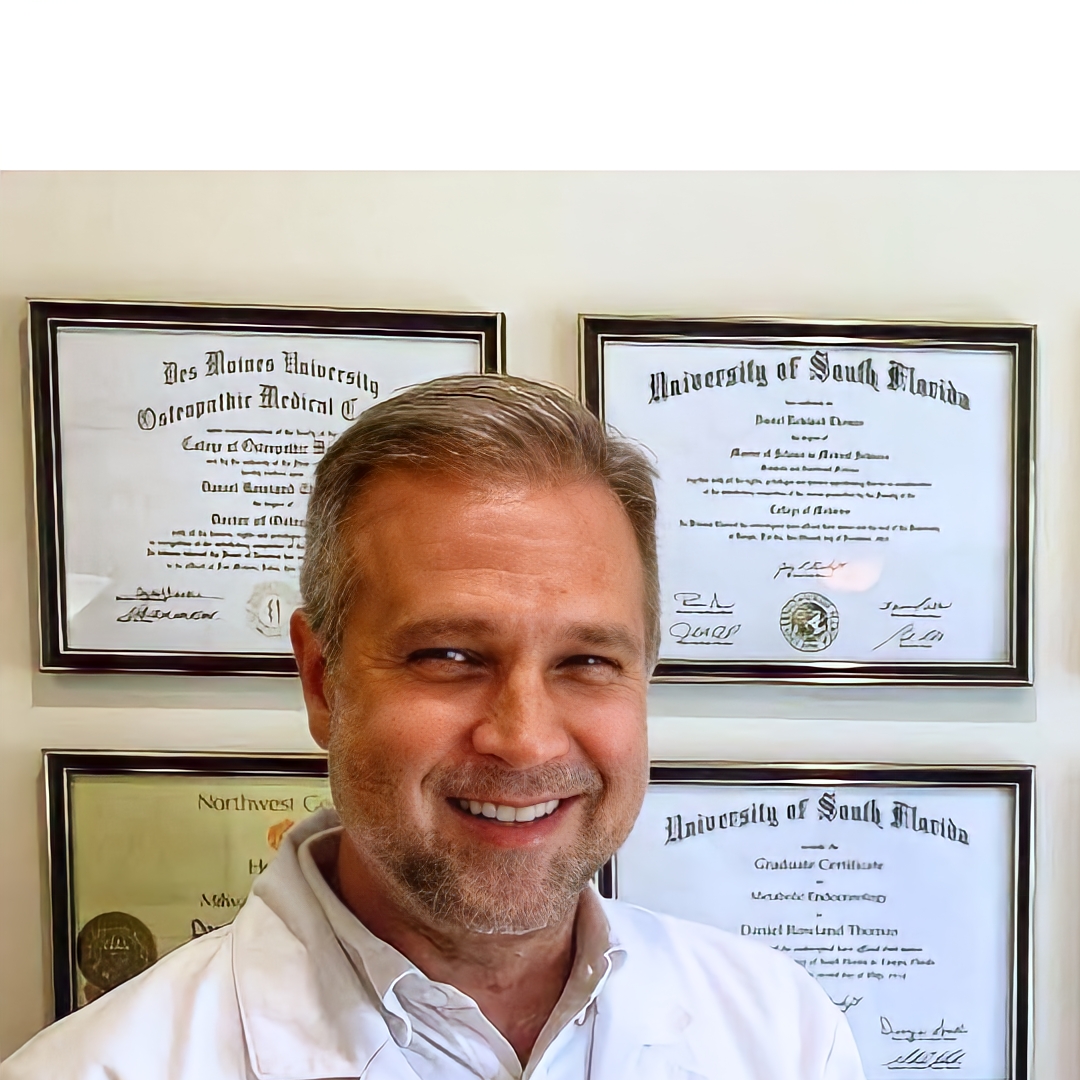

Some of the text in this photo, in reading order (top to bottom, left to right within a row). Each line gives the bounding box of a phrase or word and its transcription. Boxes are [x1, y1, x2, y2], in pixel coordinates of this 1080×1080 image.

[163, 350, 378, 400] Des Moines University
[649, 350, 970, 410] University of South Florida
[138, 392, 252, 430] Osteopathic
[259, 384, 332, 415] Medical
[199, 795, 293, 811] Northwest
[666, 793, 969, 845] University of South Florida
[755, 858, 814, 870] Graduate
